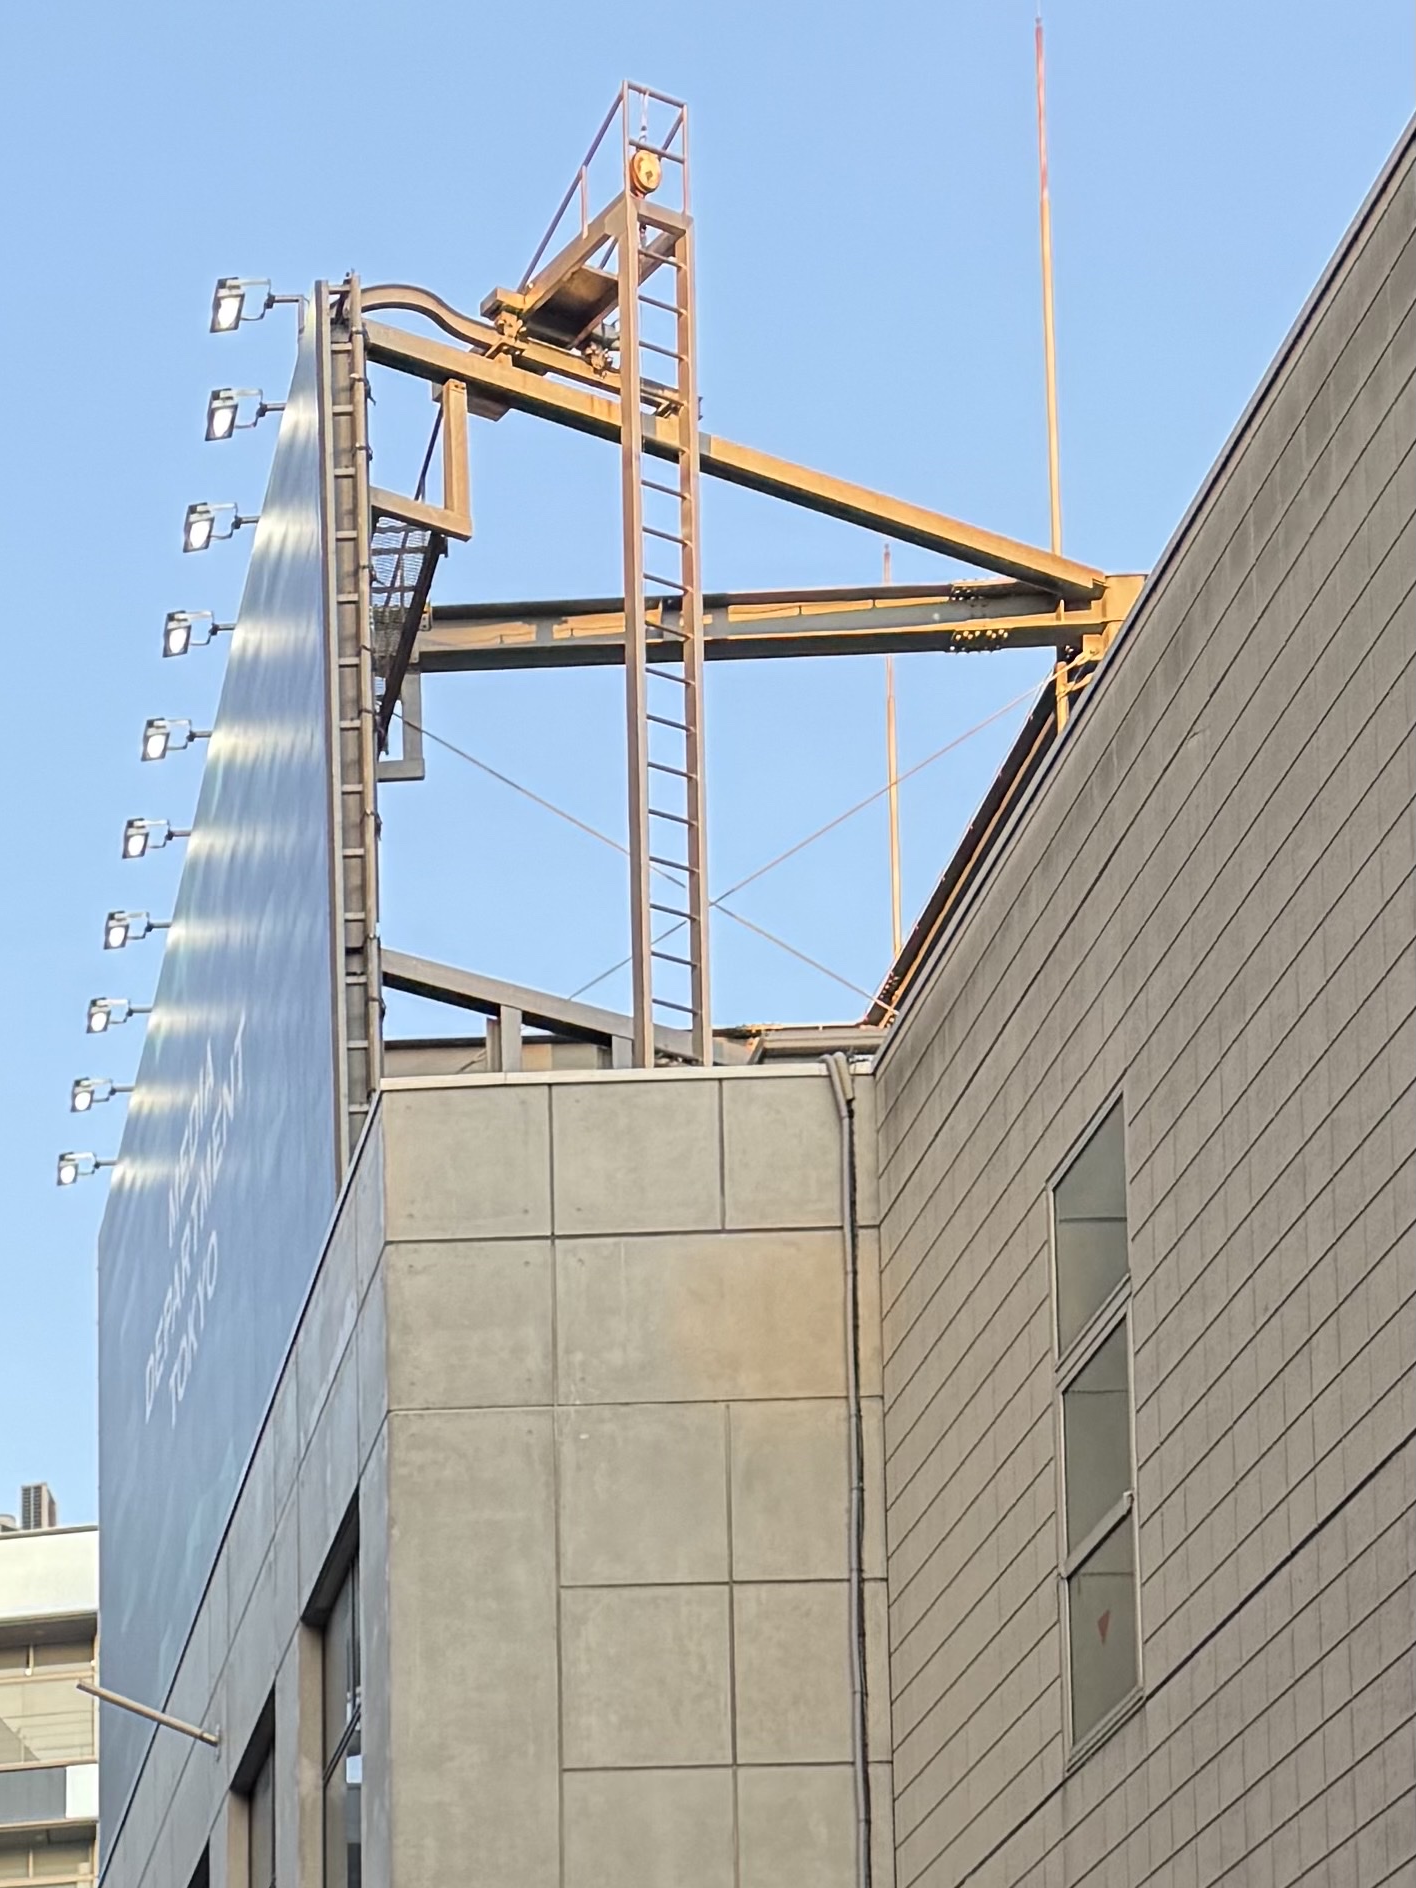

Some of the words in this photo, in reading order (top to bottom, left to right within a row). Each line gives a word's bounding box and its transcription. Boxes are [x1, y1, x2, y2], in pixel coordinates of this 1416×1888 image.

[145, 1008, 245, 1425] DEPARTMENT
[169, 1037, 214, 1248] MEDIA
[168, 1229, 218, 1430] TOKYO
